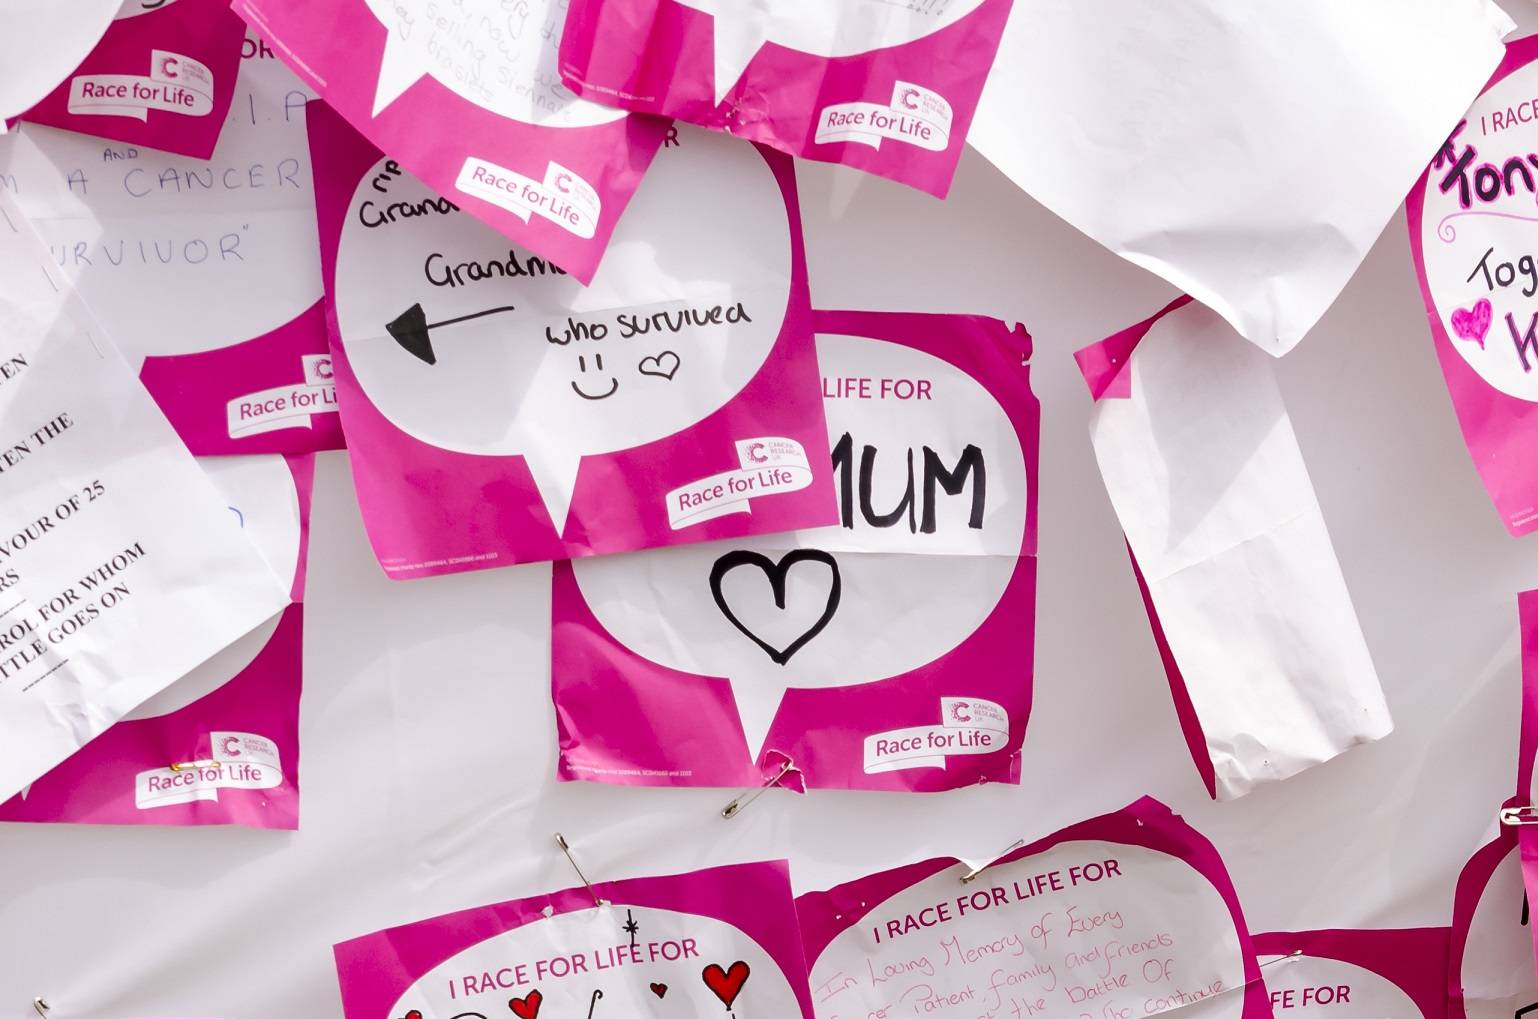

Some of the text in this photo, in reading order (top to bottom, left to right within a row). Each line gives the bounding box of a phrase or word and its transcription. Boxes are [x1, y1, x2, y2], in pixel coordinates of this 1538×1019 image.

[82, 79, 195, 108] Race for Life
[103, 147, 139, 163] AND
[124, 158, 301, 199] CANCER
[545, 302, 753, 347] who survived
[823, 377, 932, 400] LIFE FOR
[30, 412, 75, 448] THE
[55, 479, 107, 521] OF 25
[39, 542, 149, 622] FOR WHOM
[47, 581, 132, 645] GOES ON
[876, 728, 992, 758] Race for Life
[147, 771, 196, 794] Race
[228, 764, 262, 783] Life
[888, 857, 1123, 939] RACE FOR LIFE FOR
[463, 937, 701, 997] RACE FOR FOR
